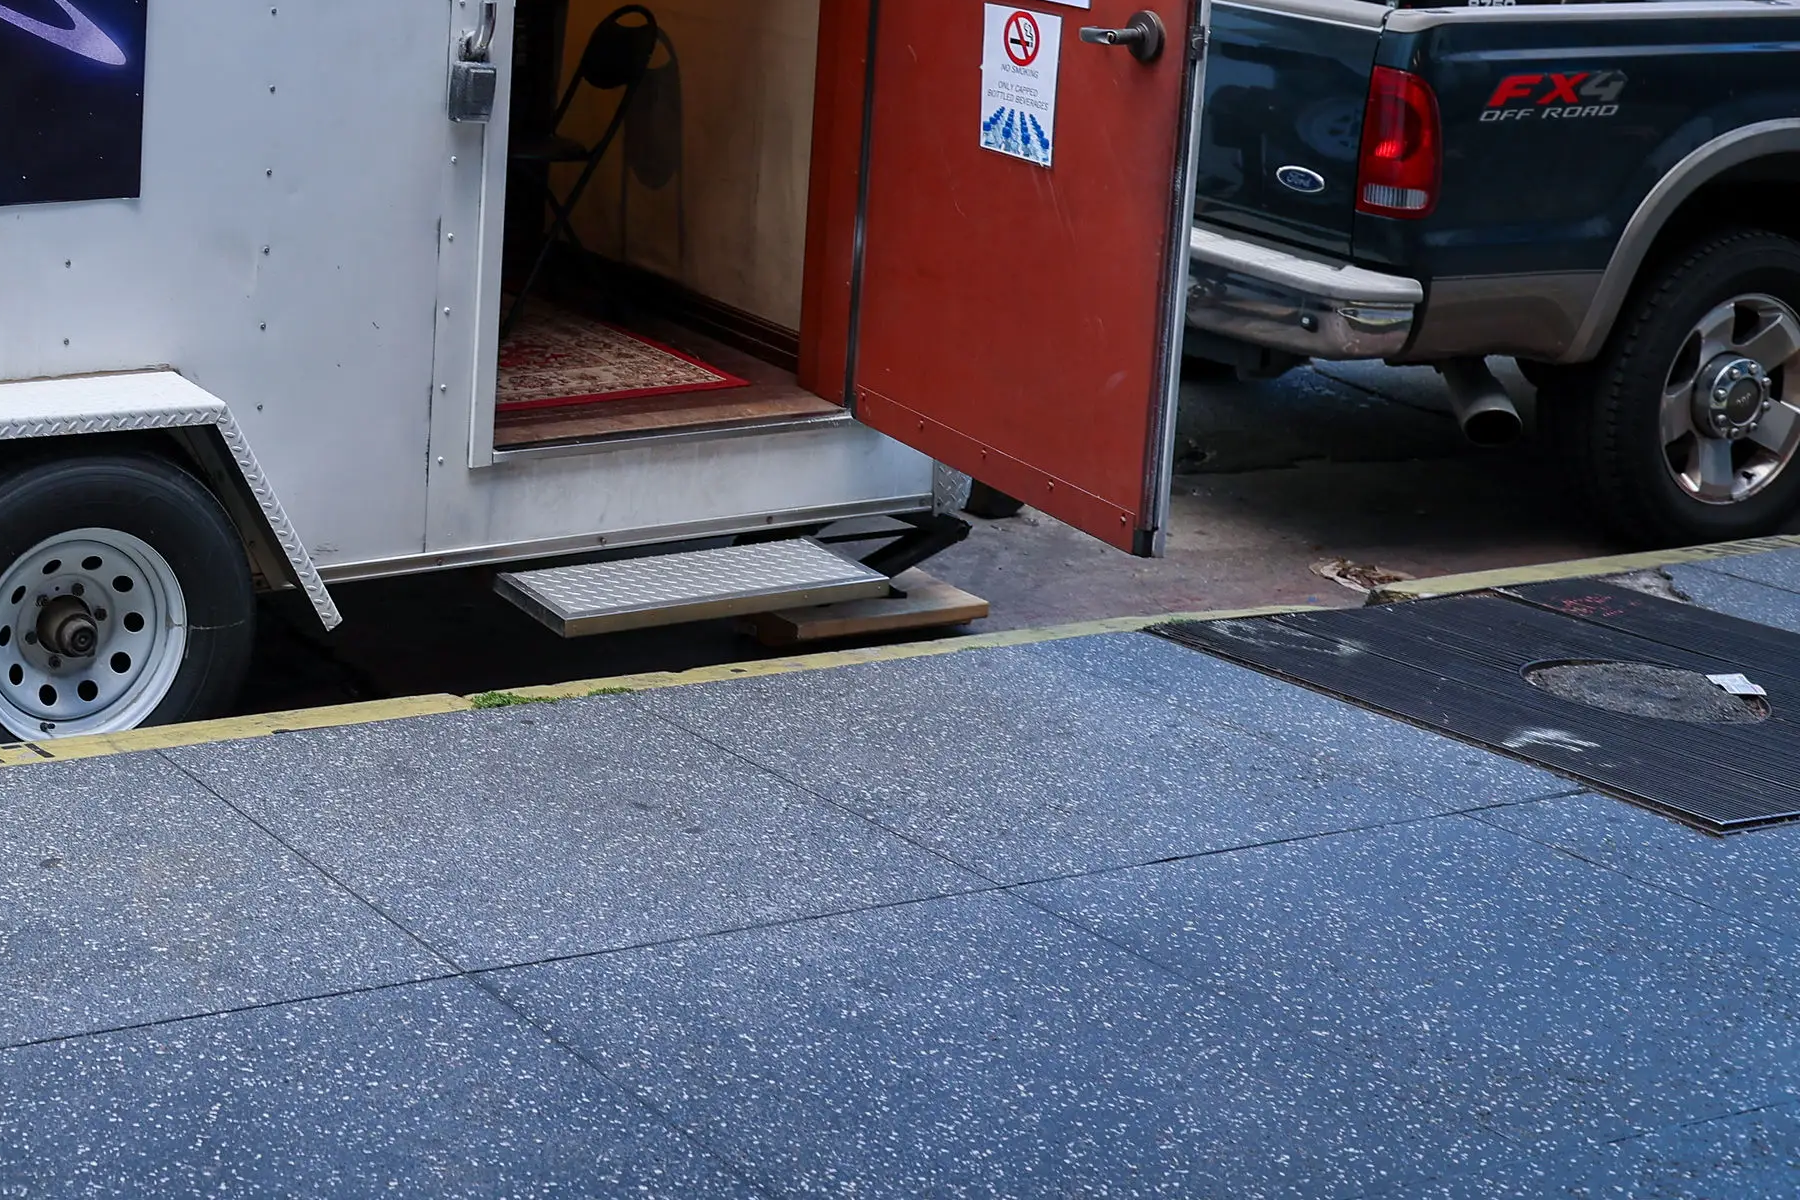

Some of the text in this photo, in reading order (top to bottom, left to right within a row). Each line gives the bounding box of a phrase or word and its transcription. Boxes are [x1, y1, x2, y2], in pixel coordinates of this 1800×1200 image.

[1001, 63, 1039, 79] NO SMOKING
[998, 81, 1038, 97] ONLY CAPPED
[1487, 70, 1629, 107] FX4
[987, 89, 1049, 111] BOTTLED BEVERAGES
[1479, 105, 1619, 121] OFF ROAD
